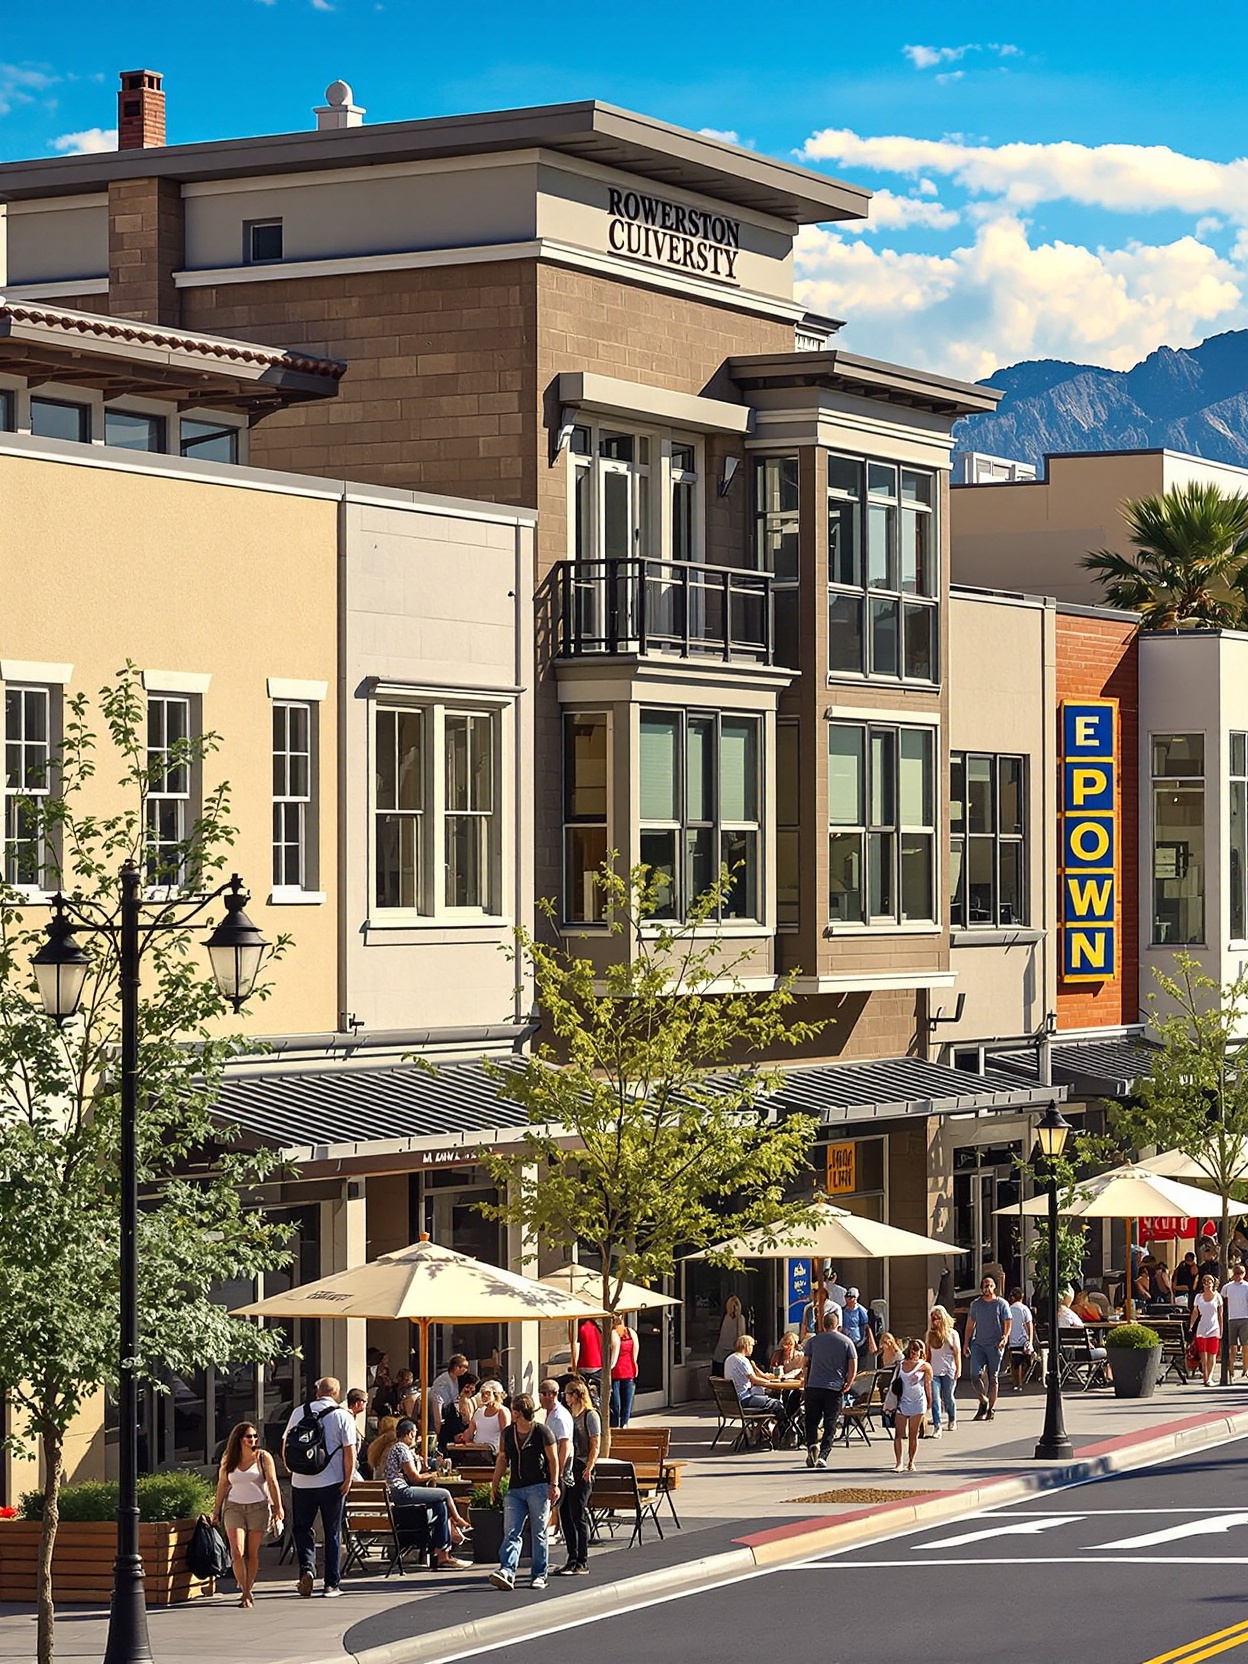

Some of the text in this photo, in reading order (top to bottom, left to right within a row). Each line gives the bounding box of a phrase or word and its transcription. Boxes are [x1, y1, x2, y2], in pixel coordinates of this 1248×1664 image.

[607, 187, 740, 248] ROWERSTON
[608, 218, 739, 279] CUIVERSTY
[1067, 715, 1113, 969] EPOWN
